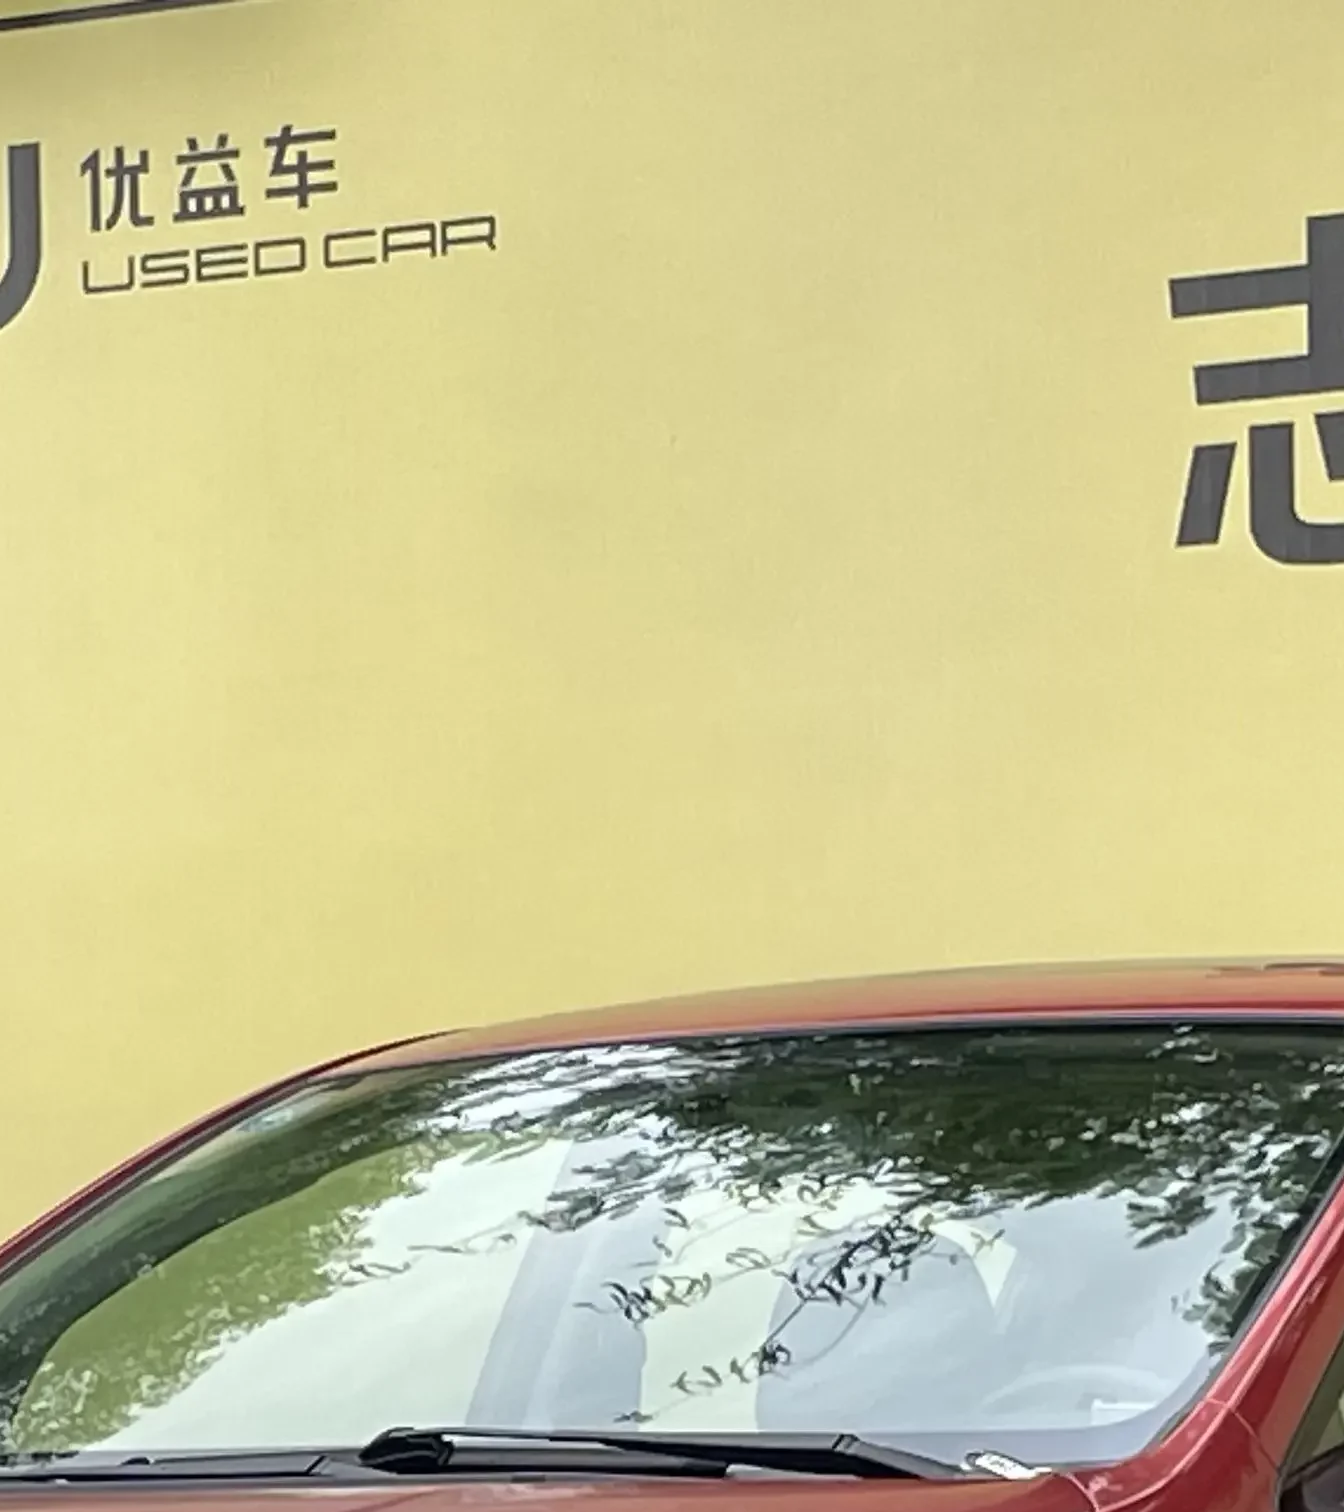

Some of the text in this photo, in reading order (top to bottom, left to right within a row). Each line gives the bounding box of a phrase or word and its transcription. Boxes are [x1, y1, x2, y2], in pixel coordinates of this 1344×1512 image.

[80, 124, 339, 233] 优益车
[82, 215, 496, 294] USED CAR
